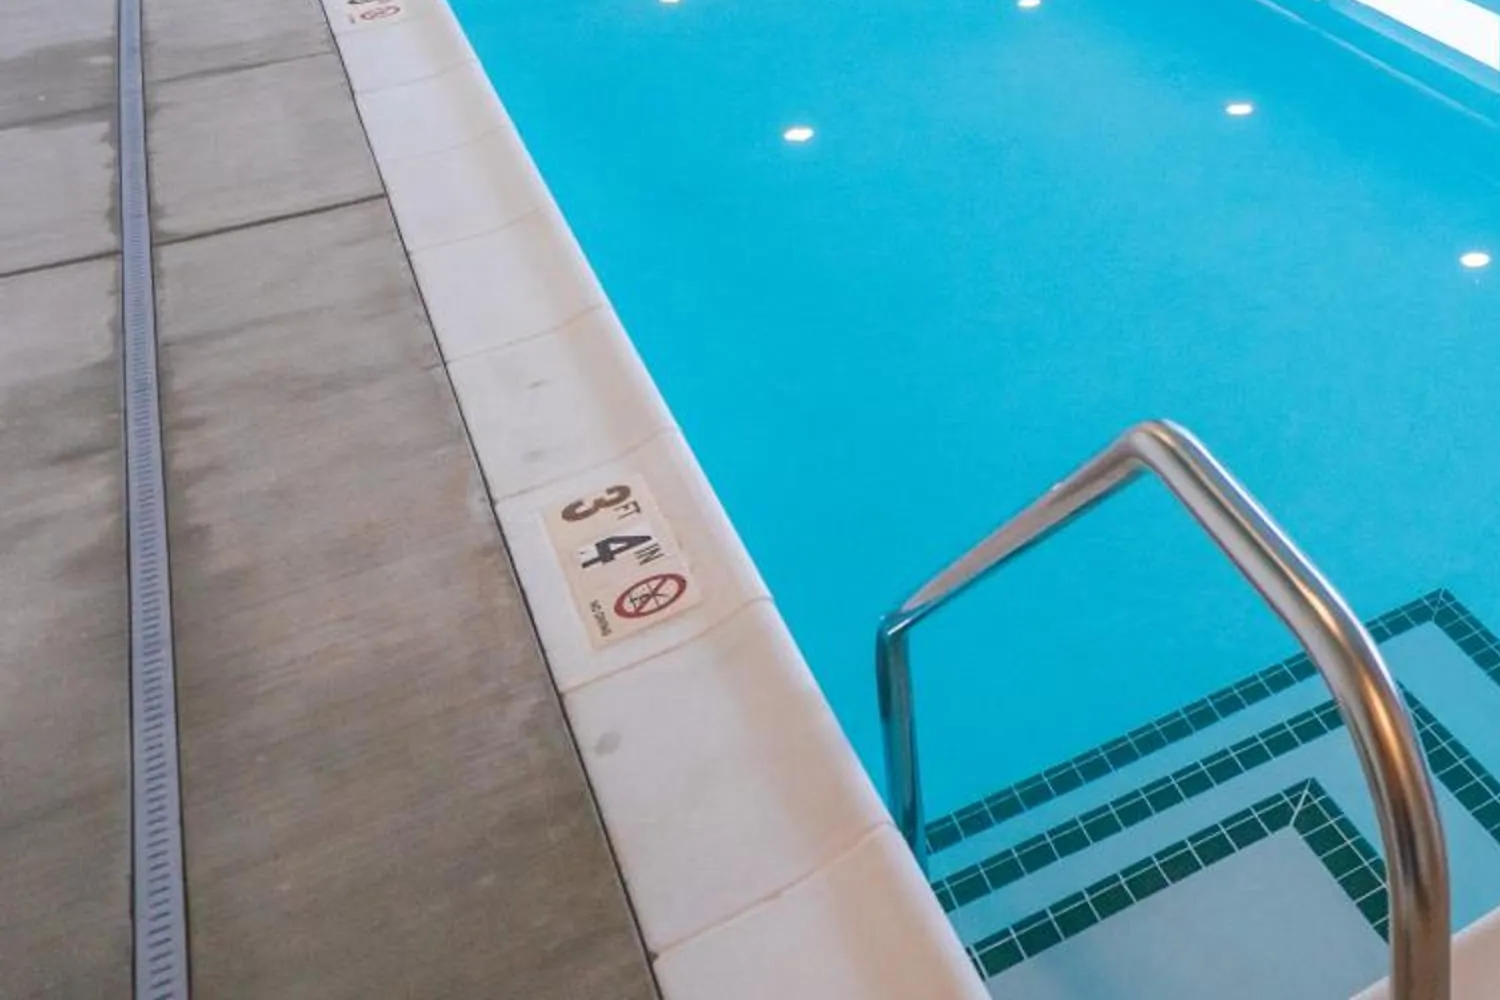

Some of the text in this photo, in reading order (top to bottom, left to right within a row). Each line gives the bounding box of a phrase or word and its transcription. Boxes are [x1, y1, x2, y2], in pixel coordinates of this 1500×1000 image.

[561, 484, 665, 569] 3 FT 4 IN
